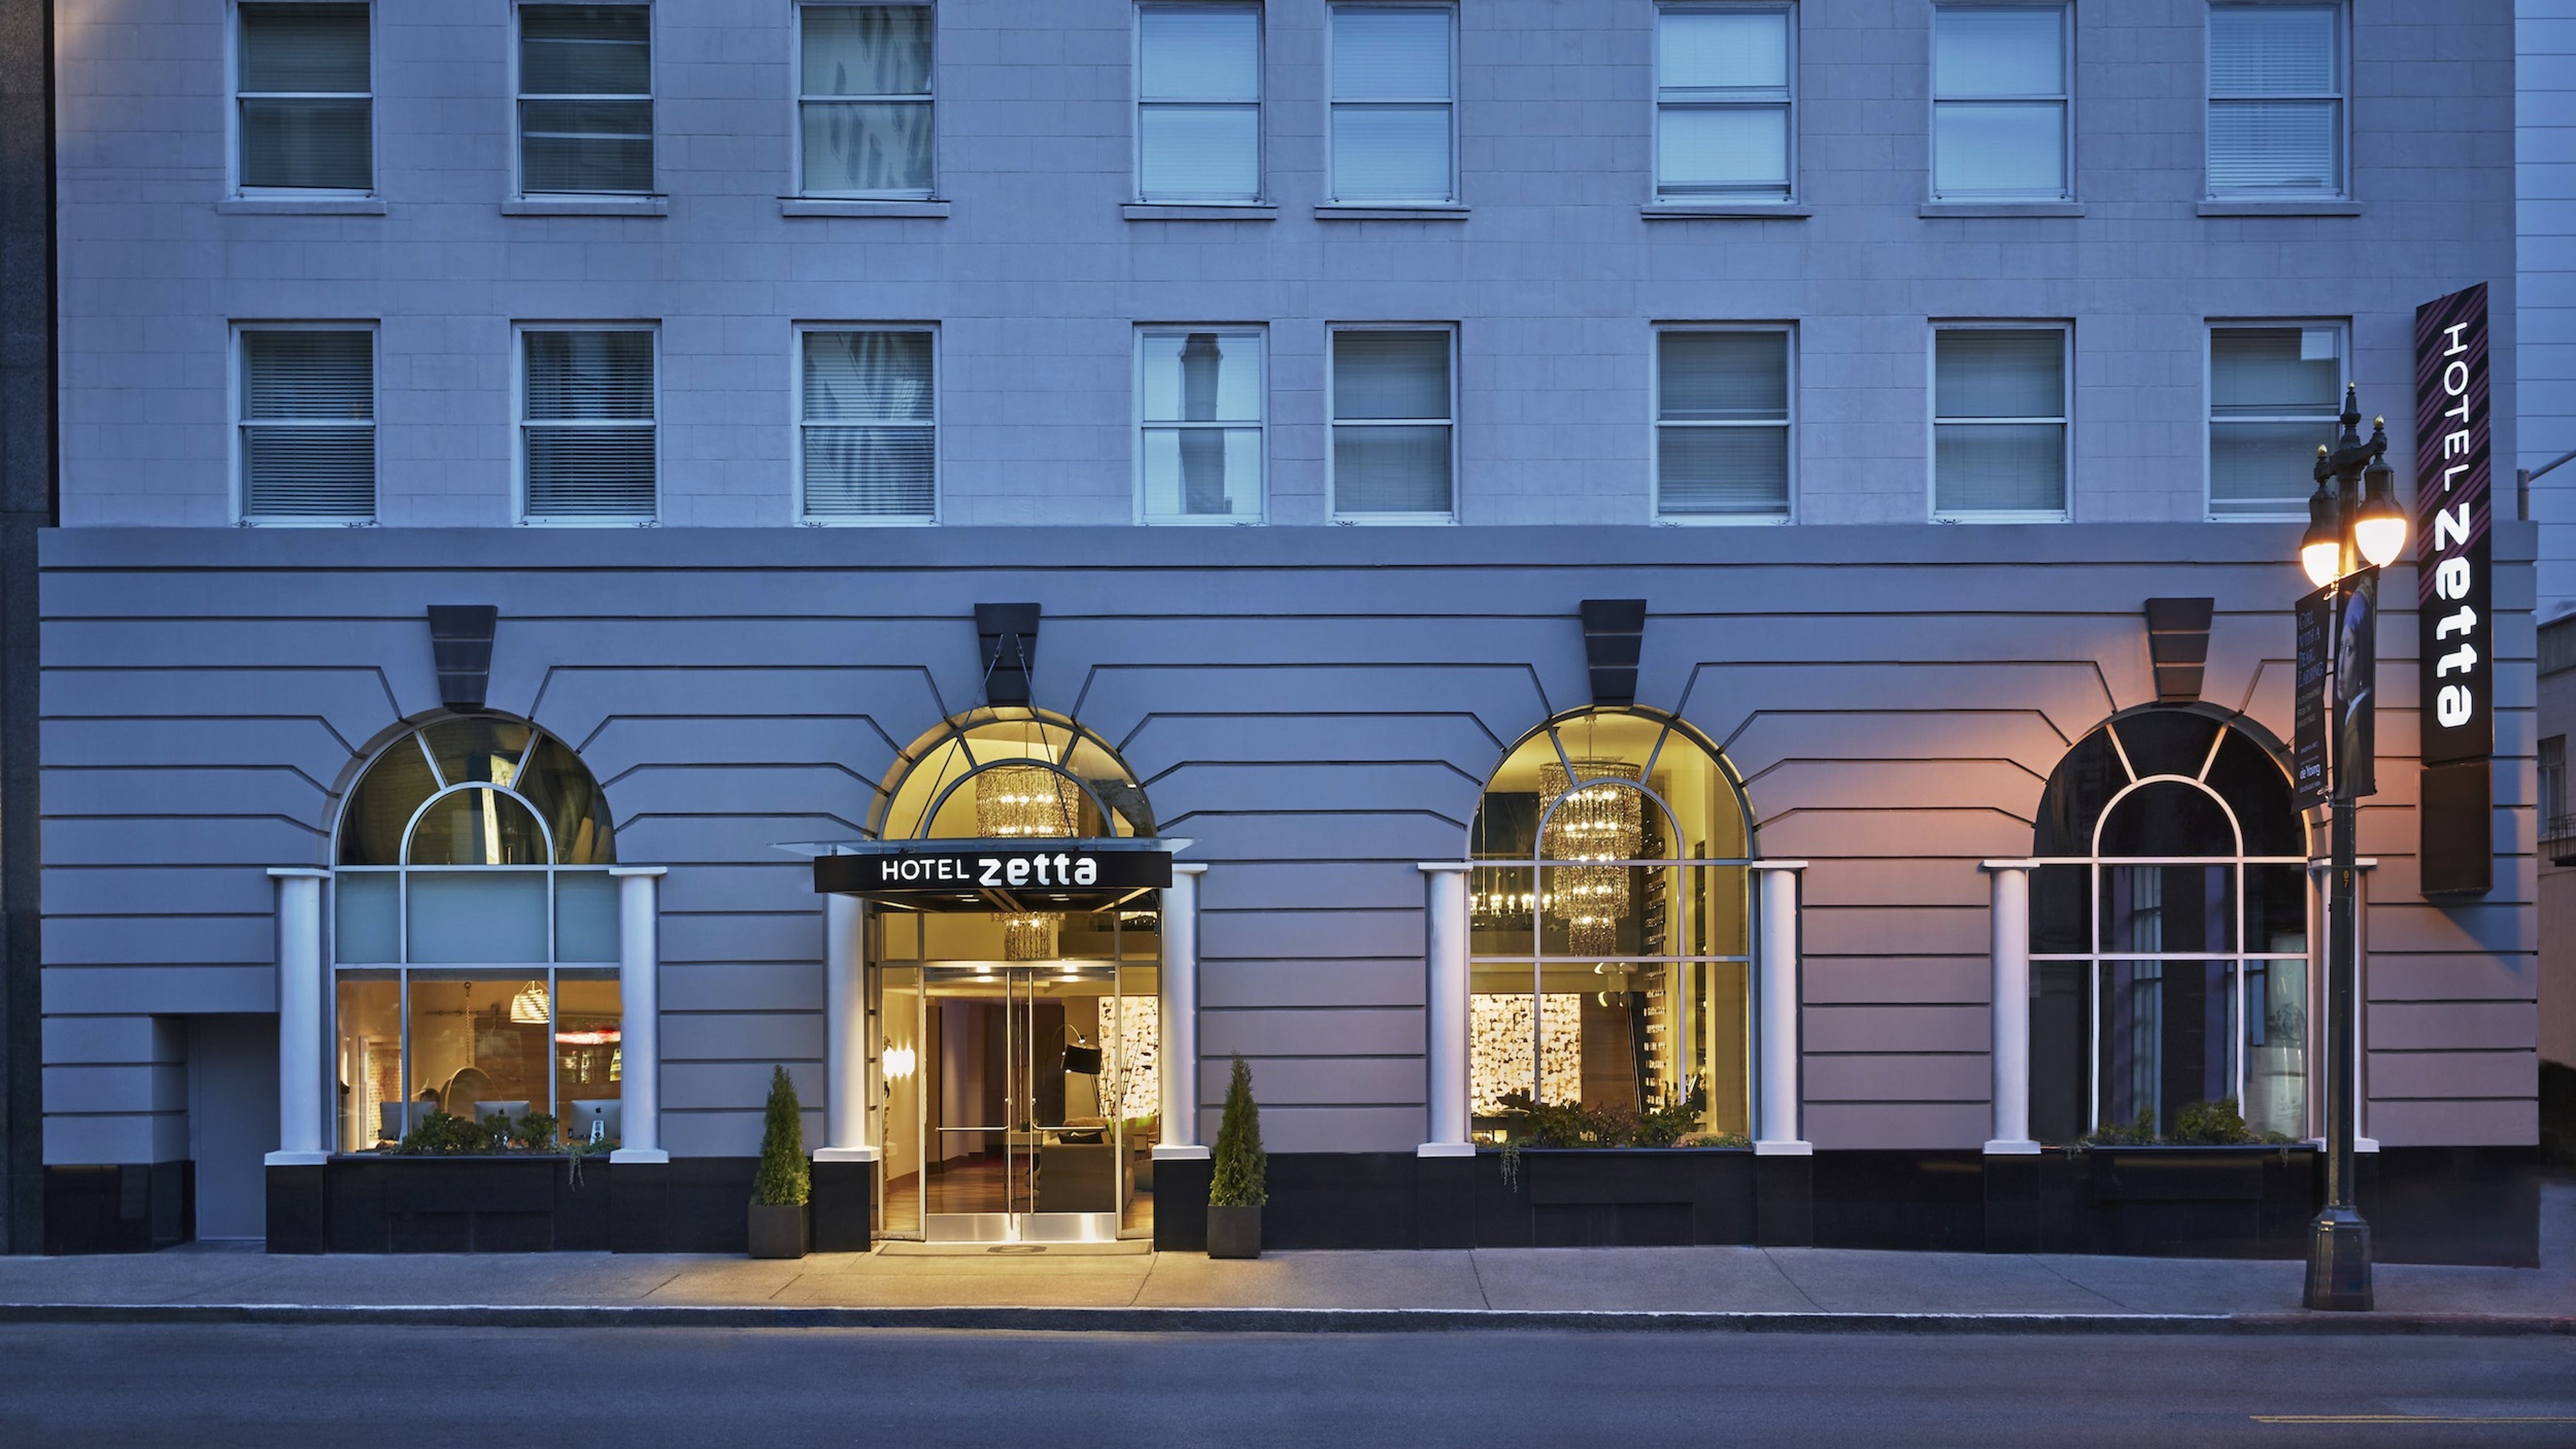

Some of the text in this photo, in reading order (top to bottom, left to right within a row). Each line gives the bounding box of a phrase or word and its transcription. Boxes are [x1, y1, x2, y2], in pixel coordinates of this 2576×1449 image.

[2435, 322, 2477, 727] HOTEL zetta
[2306, 764, 2321, 777] Young
[883, 854, 1096, 886] HOTEL zetta
